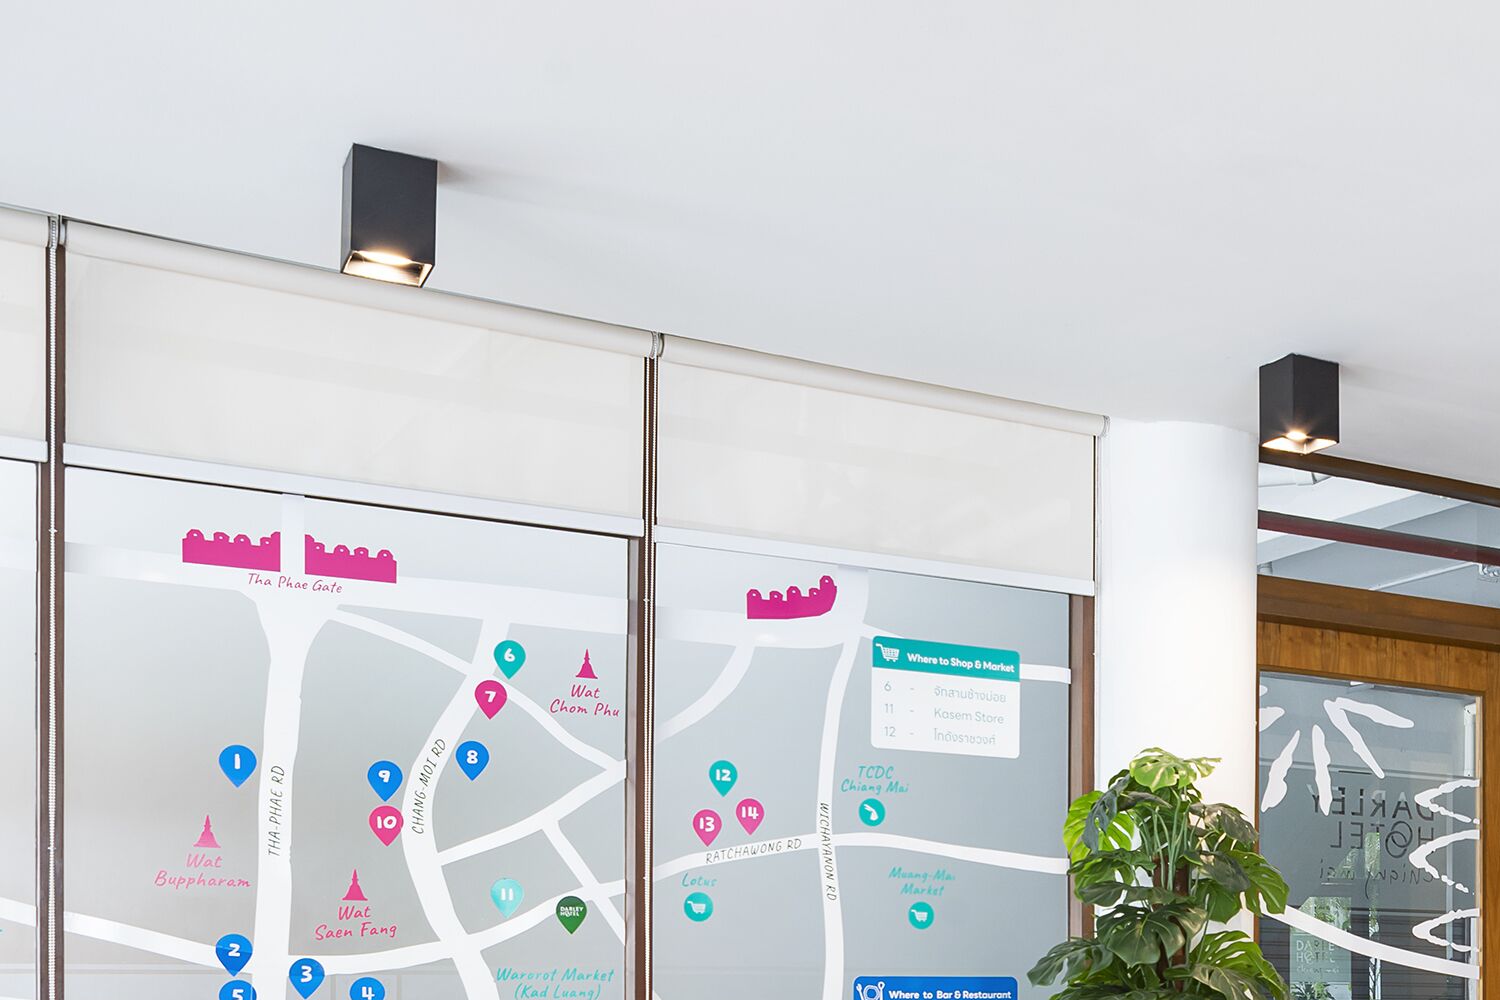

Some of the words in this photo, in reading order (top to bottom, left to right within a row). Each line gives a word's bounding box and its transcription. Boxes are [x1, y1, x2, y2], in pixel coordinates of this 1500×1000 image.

[248, 573, 271, 586] Tha
[278, 576, 308, 590] Phae
[312, 580, 343, 594] Gate
[504, 647, 516, 663] 6
[907, 652, 938, 665] Where
[939, 657, 949, 666] to
[950, 657, 974, 670] Shop
[983, 662, 1015, 673] Market
[571, 684, 600, 699] Wat
[883, 681, 892, 692] 6
[485, 691, 496, 703] 7
[550, 699, 588, 715] Chom
[594, 703, 620, 717] Phu
[885, 703, 894, 714] 11
[934, 708, 972, 721] Kasem
[975, 711, 1005, 724] Store
[884, 726, 896, 737] 12
[234, 753, 241, 770] 1
[466, 750, 478, 764] 8
[270, 765, 286, 784] RD
[378, 769, 390, 783] 9
[715, 769, 731, 782] 12
[857, 765, 894, 779] TCDC
[411, 757, 437, 834] CHANG-MOI
[431, 738, 447, 758] RD
[840, 779, 882, 795] Chiang
[886, 781, 909, 793] Mai
[741, 806, 758, 819] 14
[267, 789, 283, 857] THA-PHAE
[376, 815, 397, 829] 10
[699, 817, 715, 832] 13
[819, 802, 836, 881] WICHAYANON
[705, 841, 782, 864] RATCHAWONG
[787, 838, 802, 850] RD
[186, 854, 222, 868] Wat
[154, 870, 251, 889] Buppharam
[681, 872, 718, 888] Lotus
[501, 888, 514, 901] 11
[825, 884, 837, 901] RD
[900, 883, 944, 897] Market
[338, 905, 372, 920] Wat
[315, 924, 353, 941] Saen
[360, 922, 397, 939] Fang
[228, 943, 241, 958] 2
[301, 966, 313, 983] 3
[561, 967, 615, 982] Market
[361, 986, 375, 1000] 4
[514, 982, 549, 1000] (Kad
[553, 984, 601, 1000] Luang)
[888, 990, 920, 1000] Where
[923, 991, 934, 1000] to
[936, 990, 953, 1000] Bar
[963, 991, 1012, 1000] Restaurant
